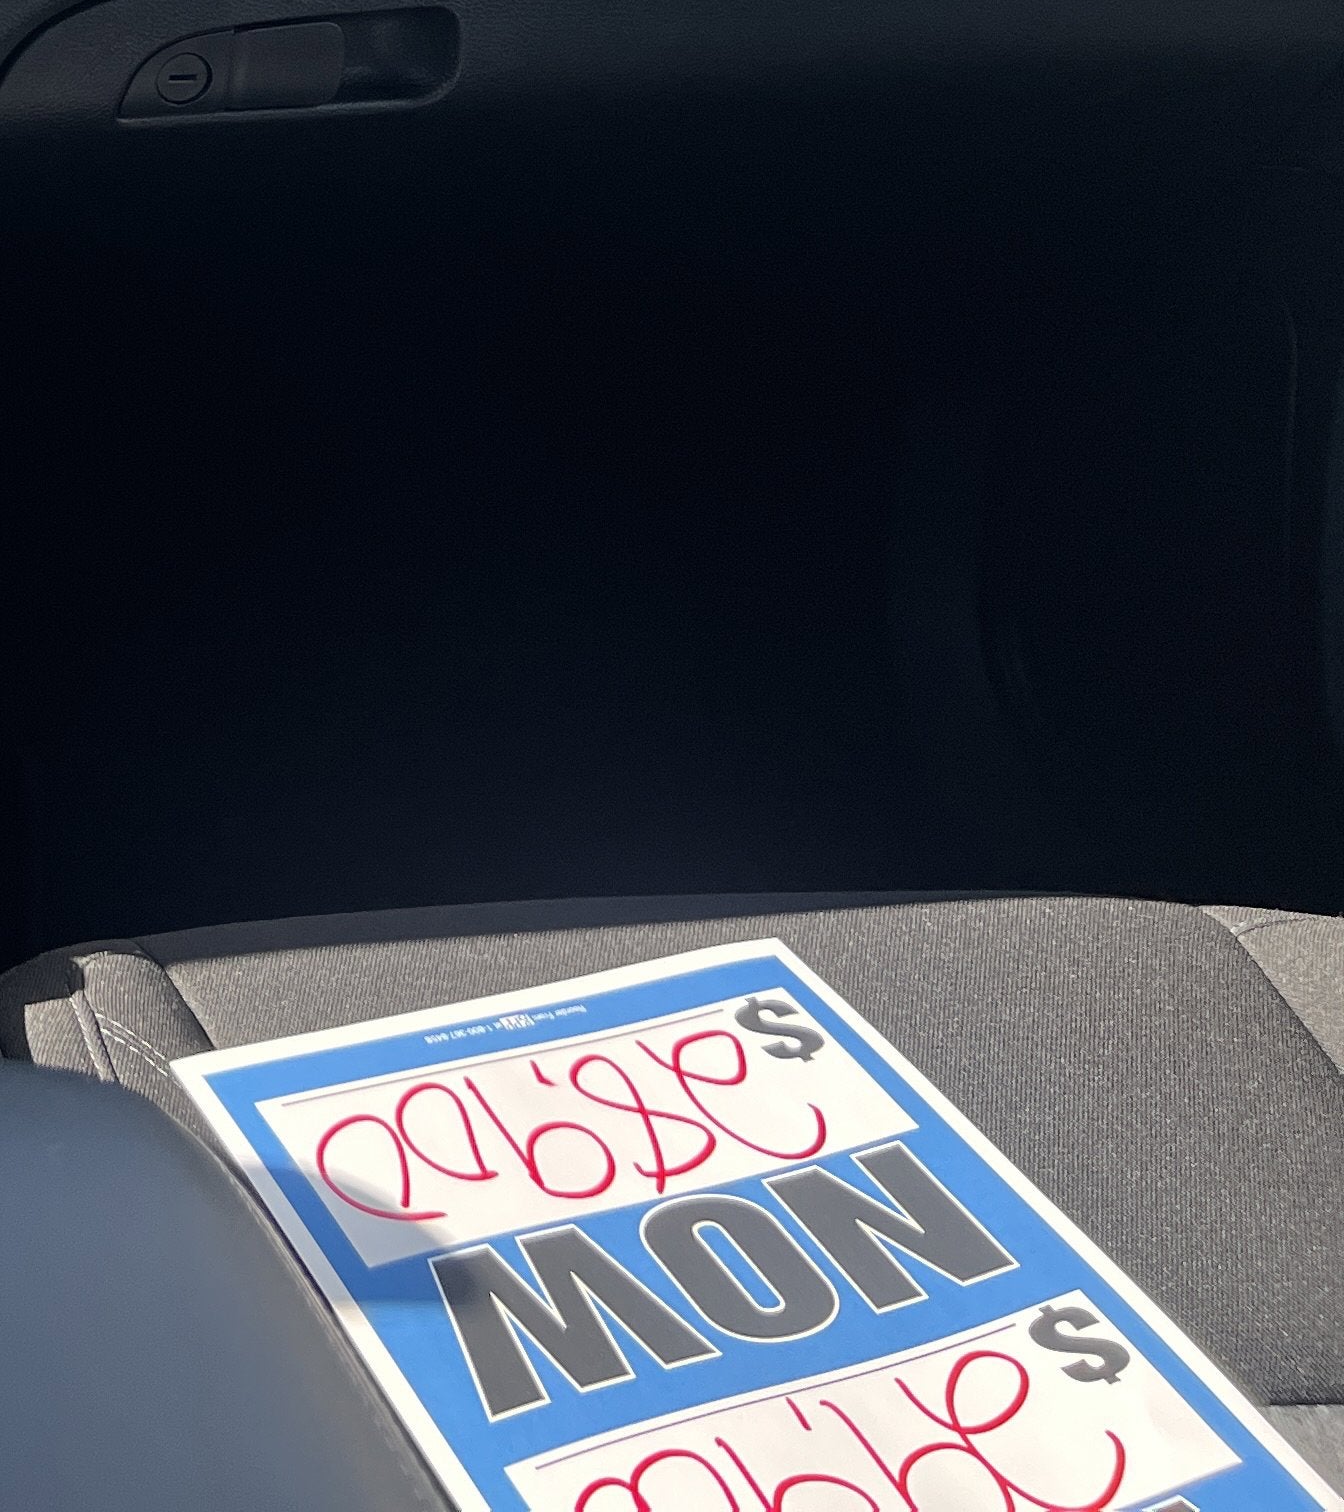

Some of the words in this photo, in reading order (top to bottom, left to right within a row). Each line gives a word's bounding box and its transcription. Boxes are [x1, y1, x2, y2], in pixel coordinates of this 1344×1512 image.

[734, 996, 825, 1063] $
[428, 1140, 1020, 1423] NOW
[1028, 1304, 1131, 1385] $
